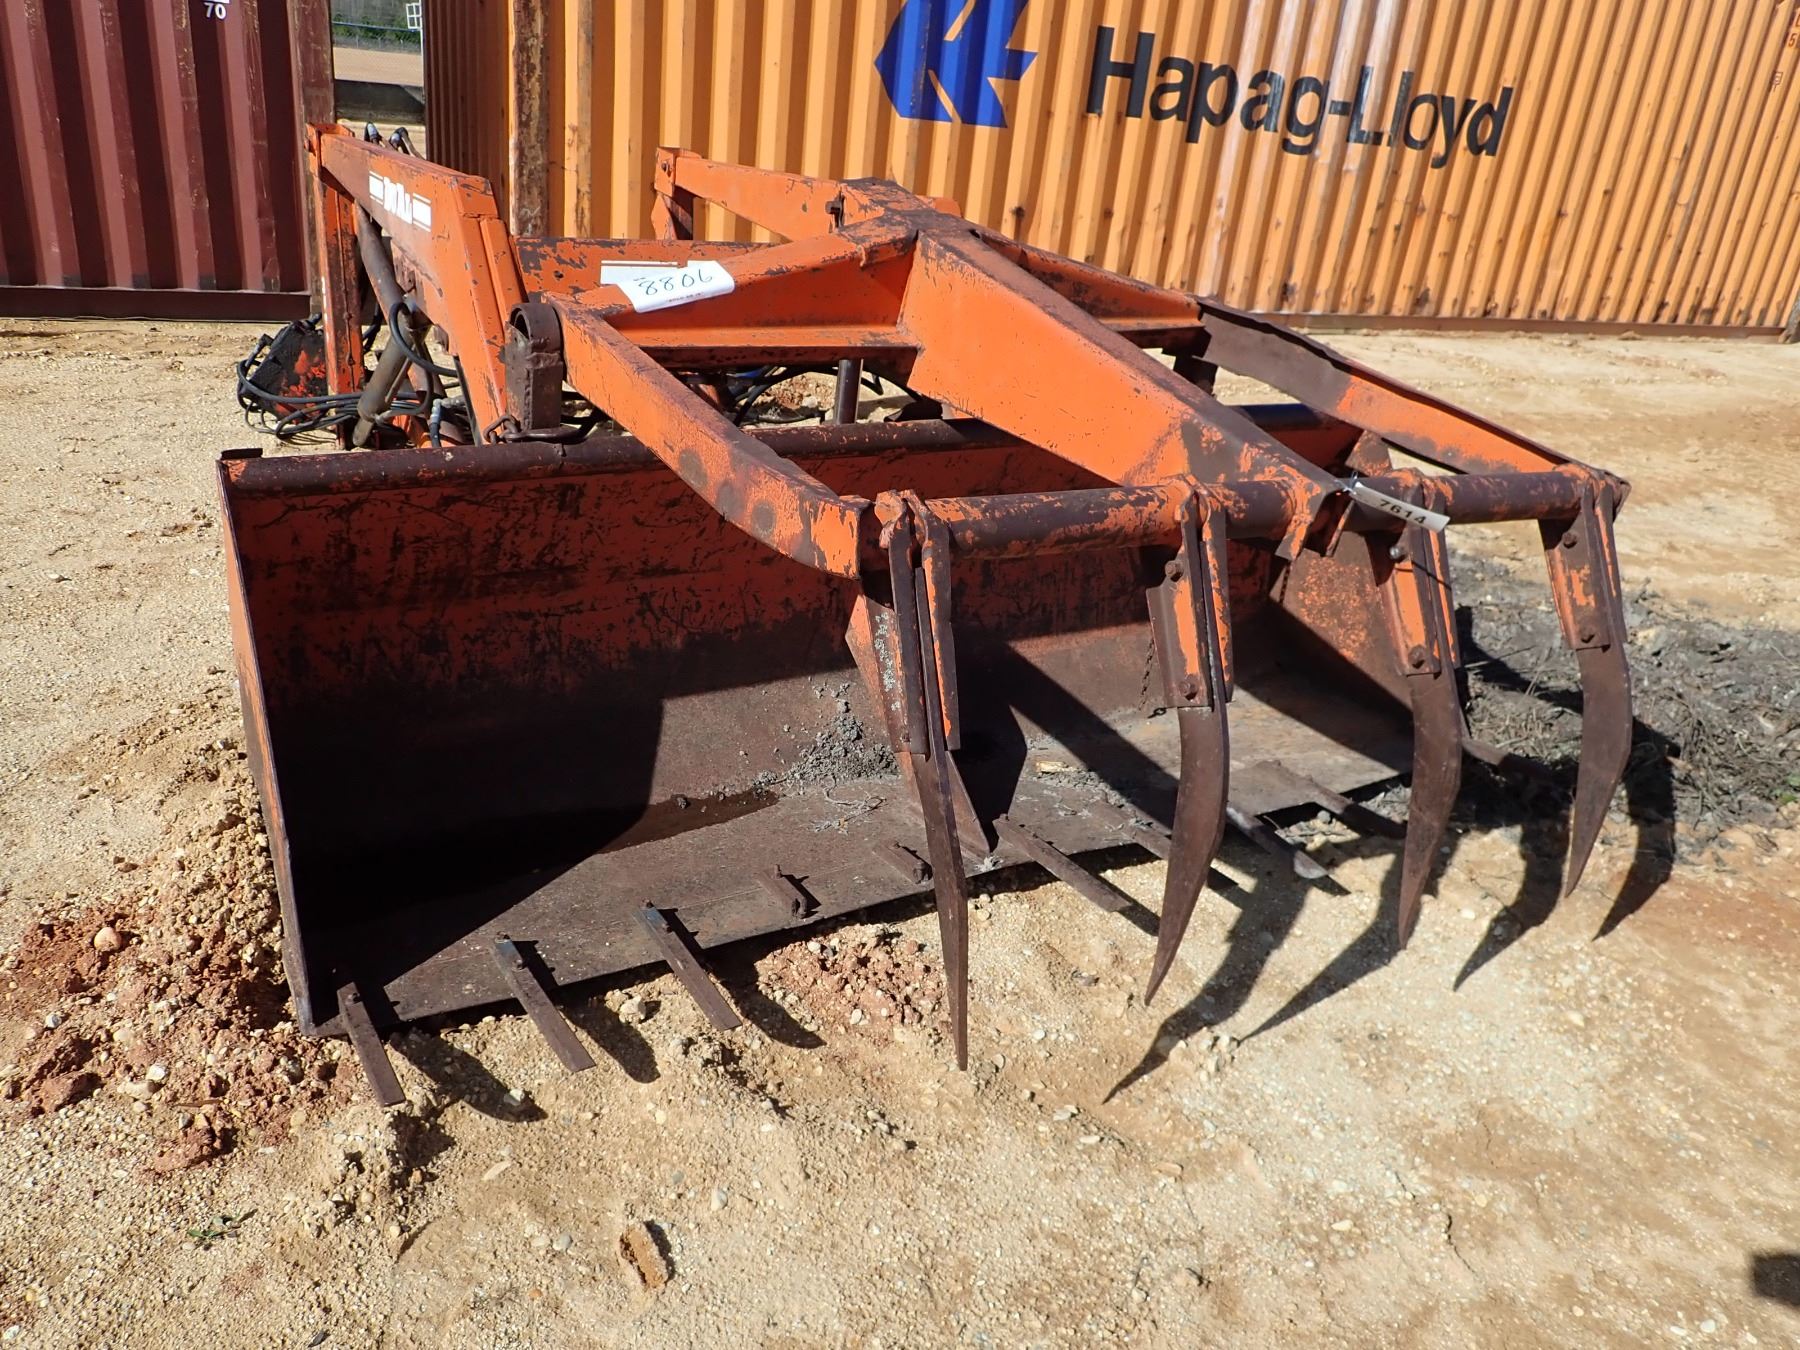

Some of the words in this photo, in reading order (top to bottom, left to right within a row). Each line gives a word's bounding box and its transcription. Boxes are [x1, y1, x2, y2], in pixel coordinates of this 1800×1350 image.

[204, 2, 226, 20] 70
[1086, 25, 1513, 169] Hapag-Lloyd
[635, 268, 713, 296] 8806
[1379, 499, 1427, 524] 7614
